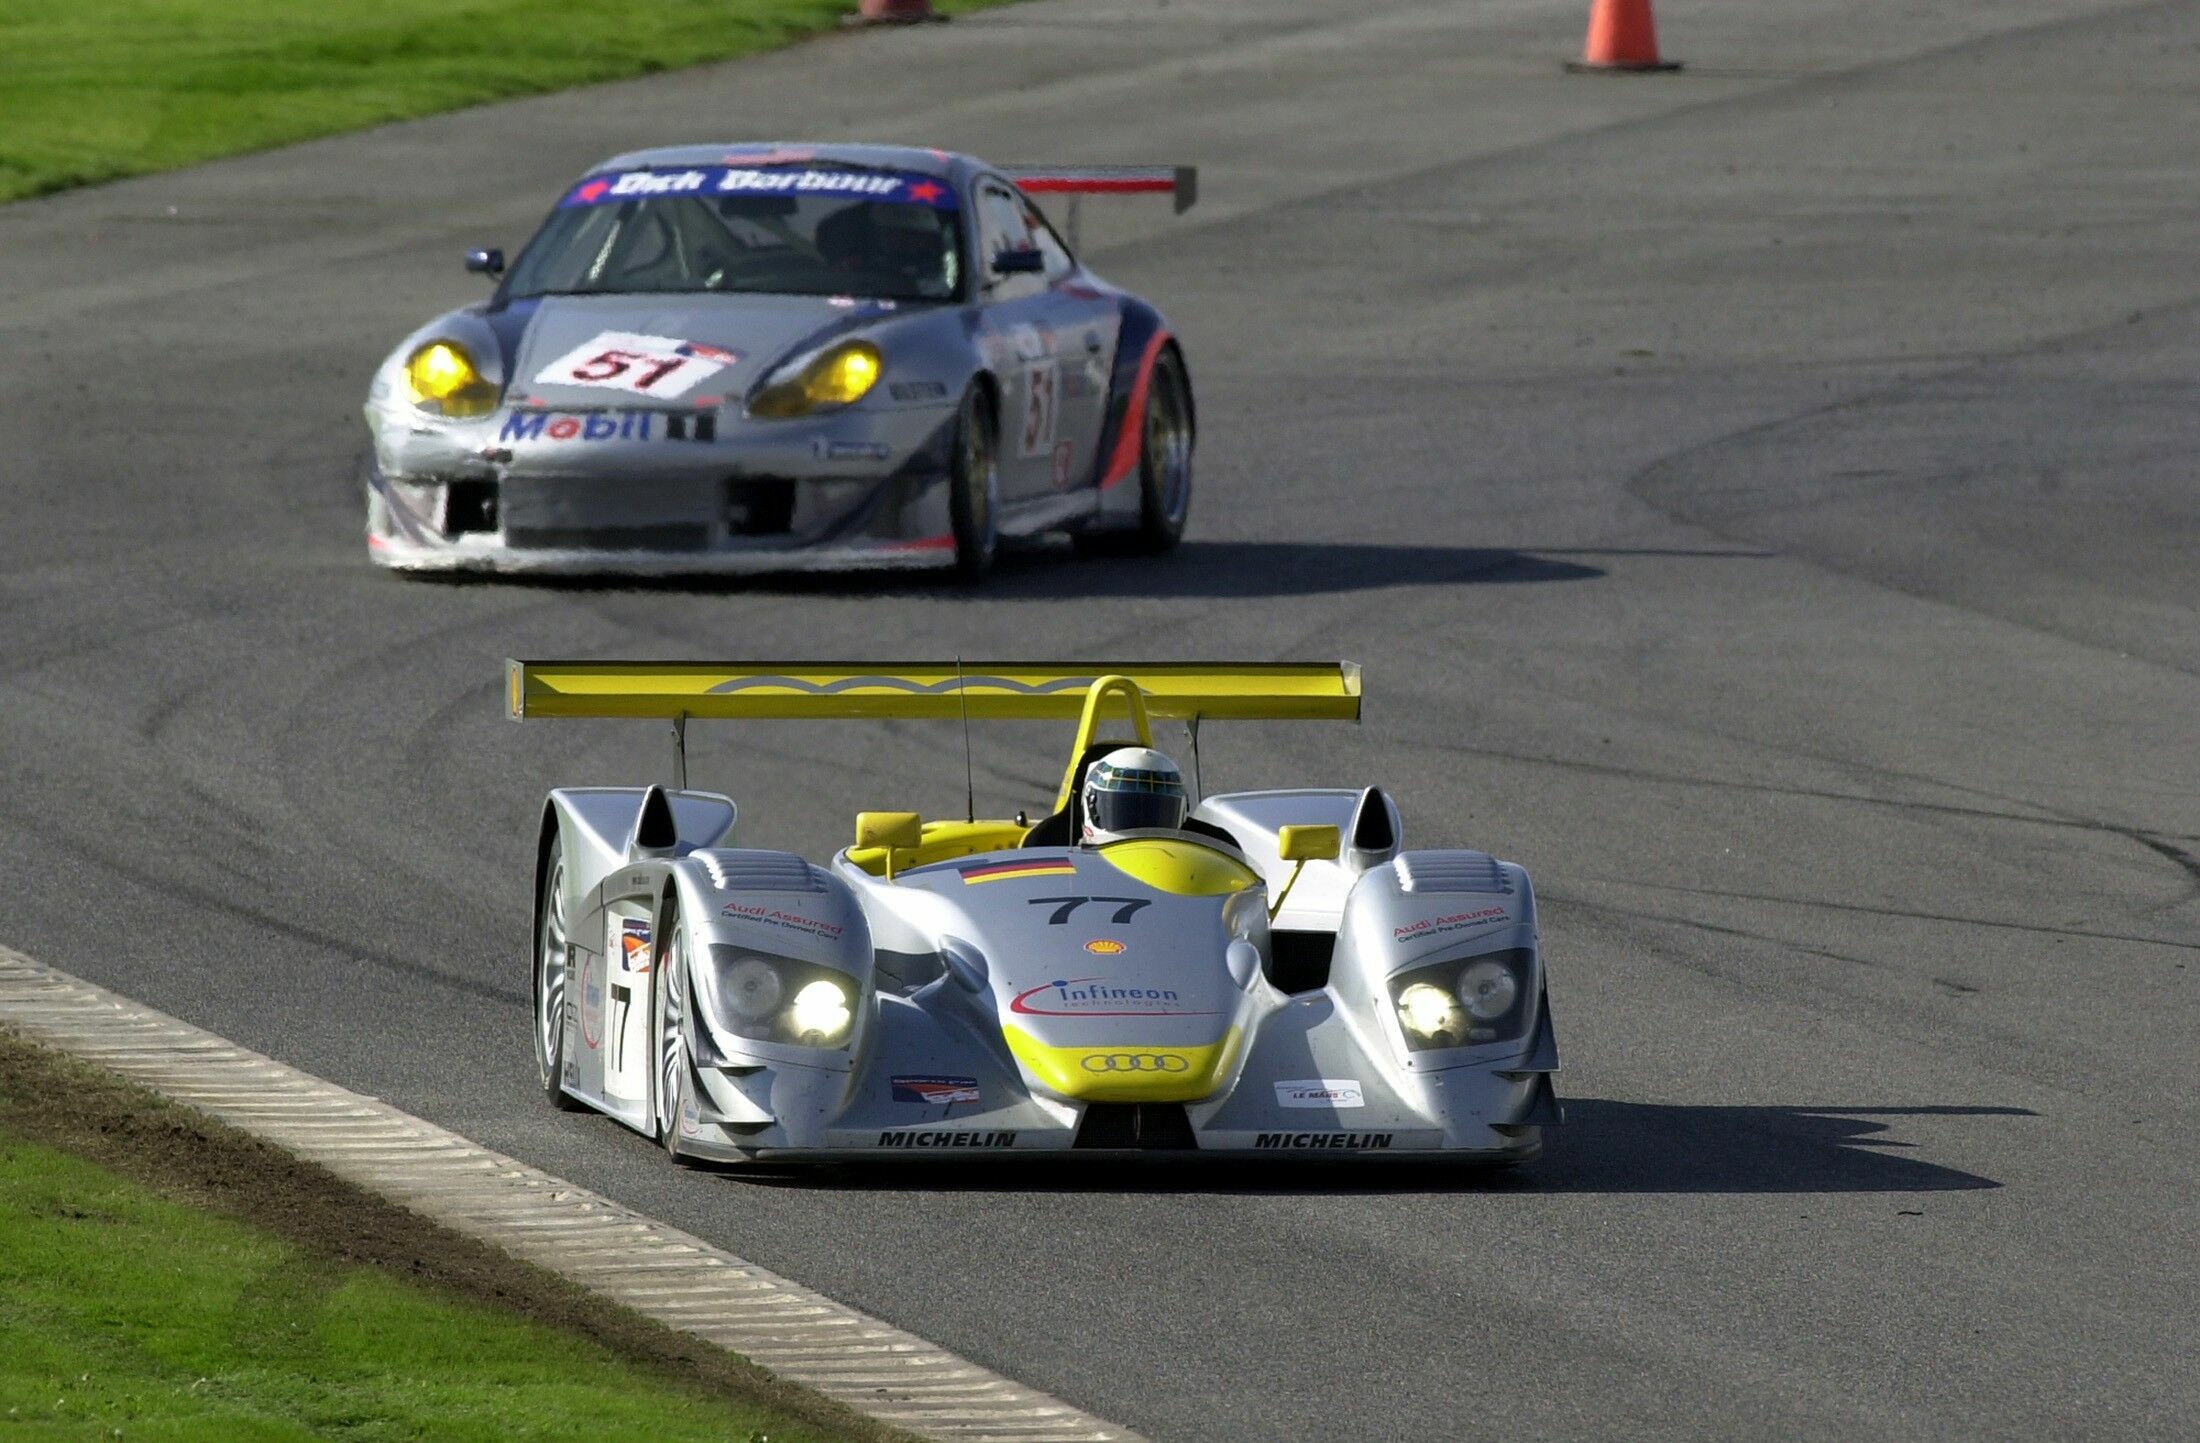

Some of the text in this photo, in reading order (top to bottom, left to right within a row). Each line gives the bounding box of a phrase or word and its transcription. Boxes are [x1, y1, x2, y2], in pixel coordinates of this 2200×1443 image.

[572, 350, 691, 390] 51
[499, 411, 650, 442] Mobil
[1028, 895, 1152, 925] 77
[1393, 905, 1505, 937] Audi Assured
[1052, 979, 1178, 1001] Infineon
[878, 1131, 1017, 1148] MICHELIN
[1255, 1133, 1393, 1149] MICHELIN
